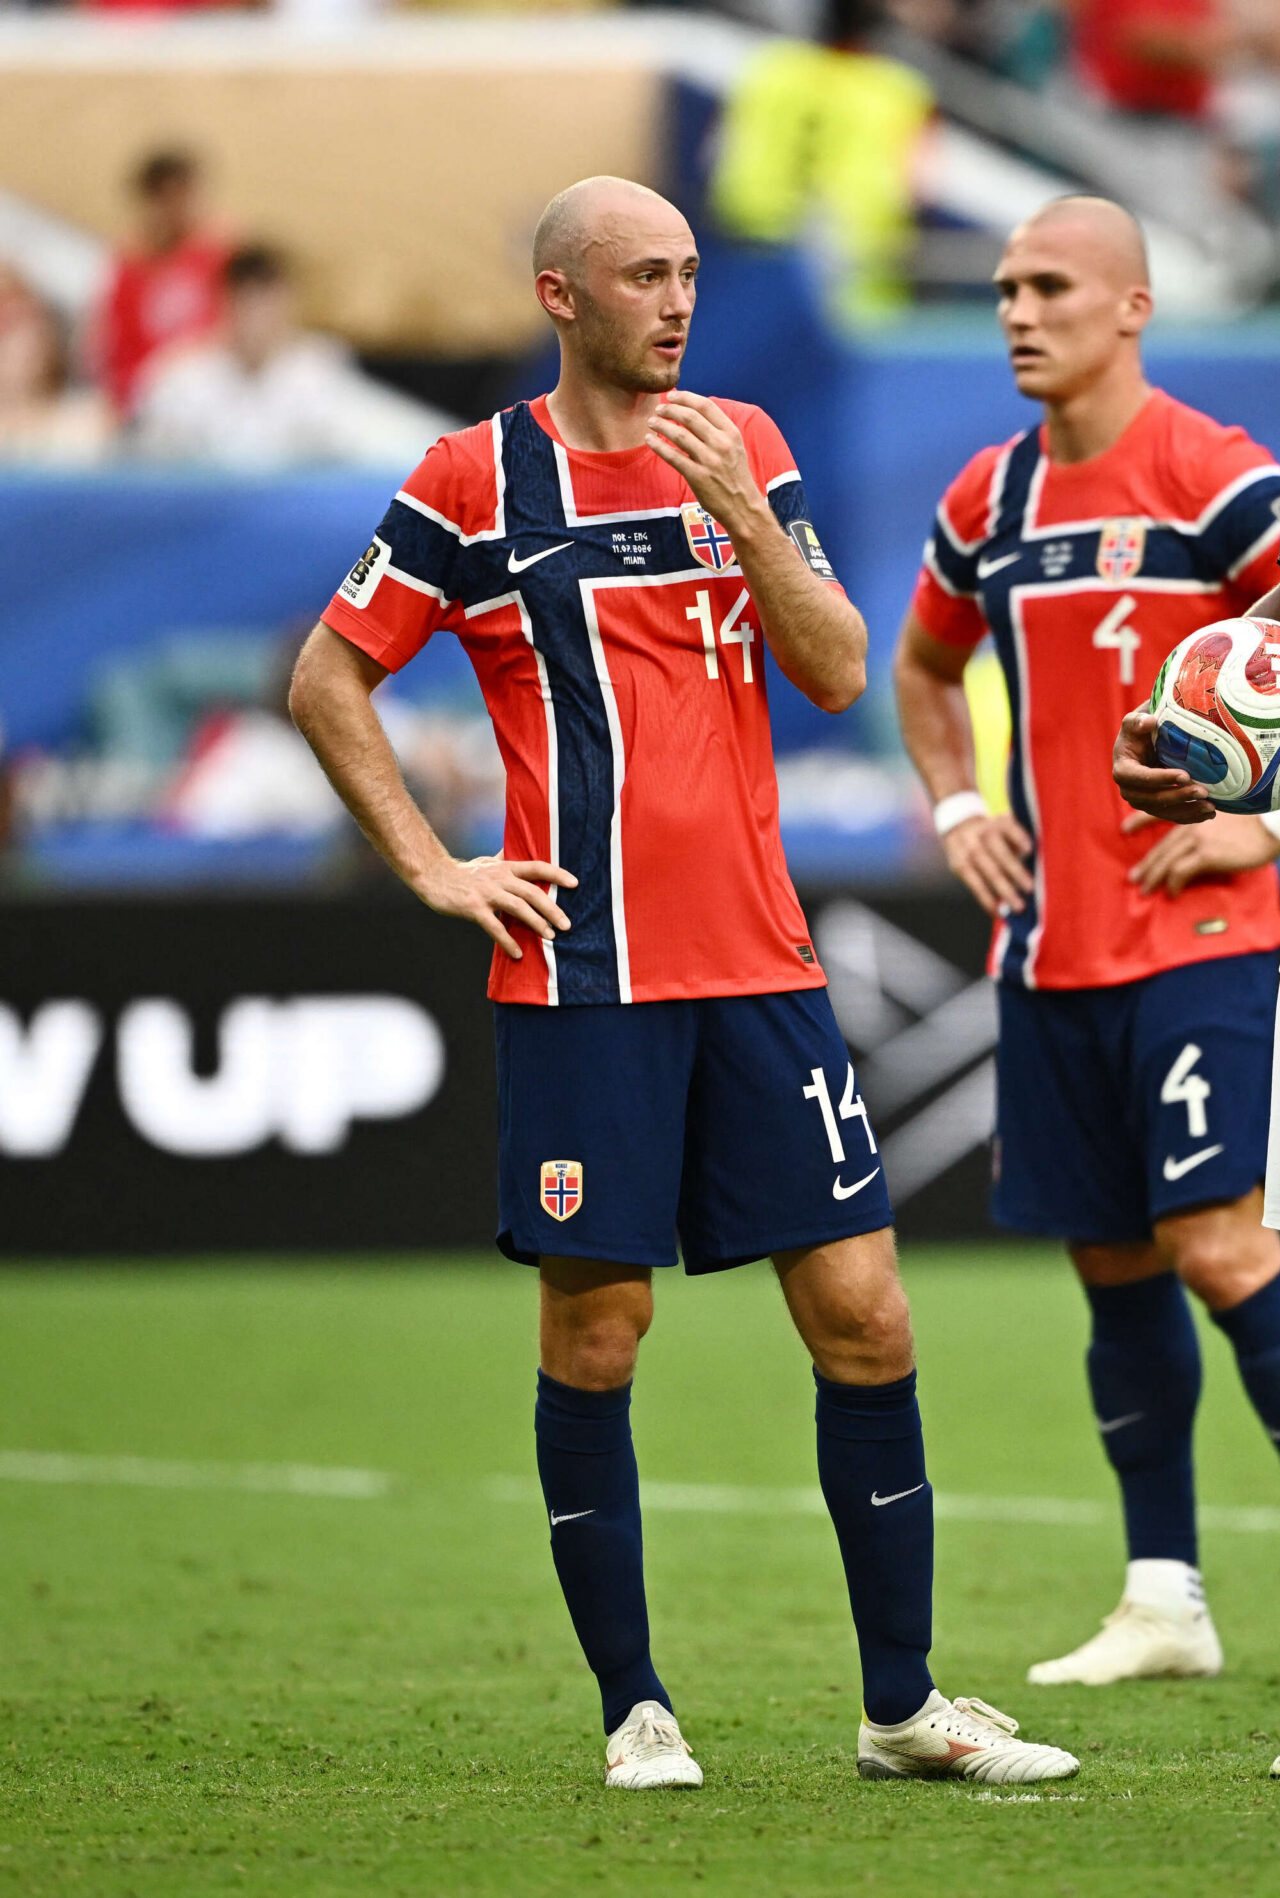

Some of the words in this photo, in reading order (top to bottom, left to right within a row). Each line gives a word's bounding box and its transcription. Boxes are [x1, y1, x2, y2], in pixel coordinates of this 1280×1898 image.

[611, 533, 626, 541] NOR
[633, 531, 648, 541] ENG
[612, 544, 652, 553] 11.07.2026
[623, 556, 646, 565] MIAMI
[685, 588, 756, 684] 14
[1092, 594, 1141, 685] 4
[116, 992, 446, 1159] UP
[802, 1061, 878, 1163] 14
[1160, 1042, 1211, 1138] 4
